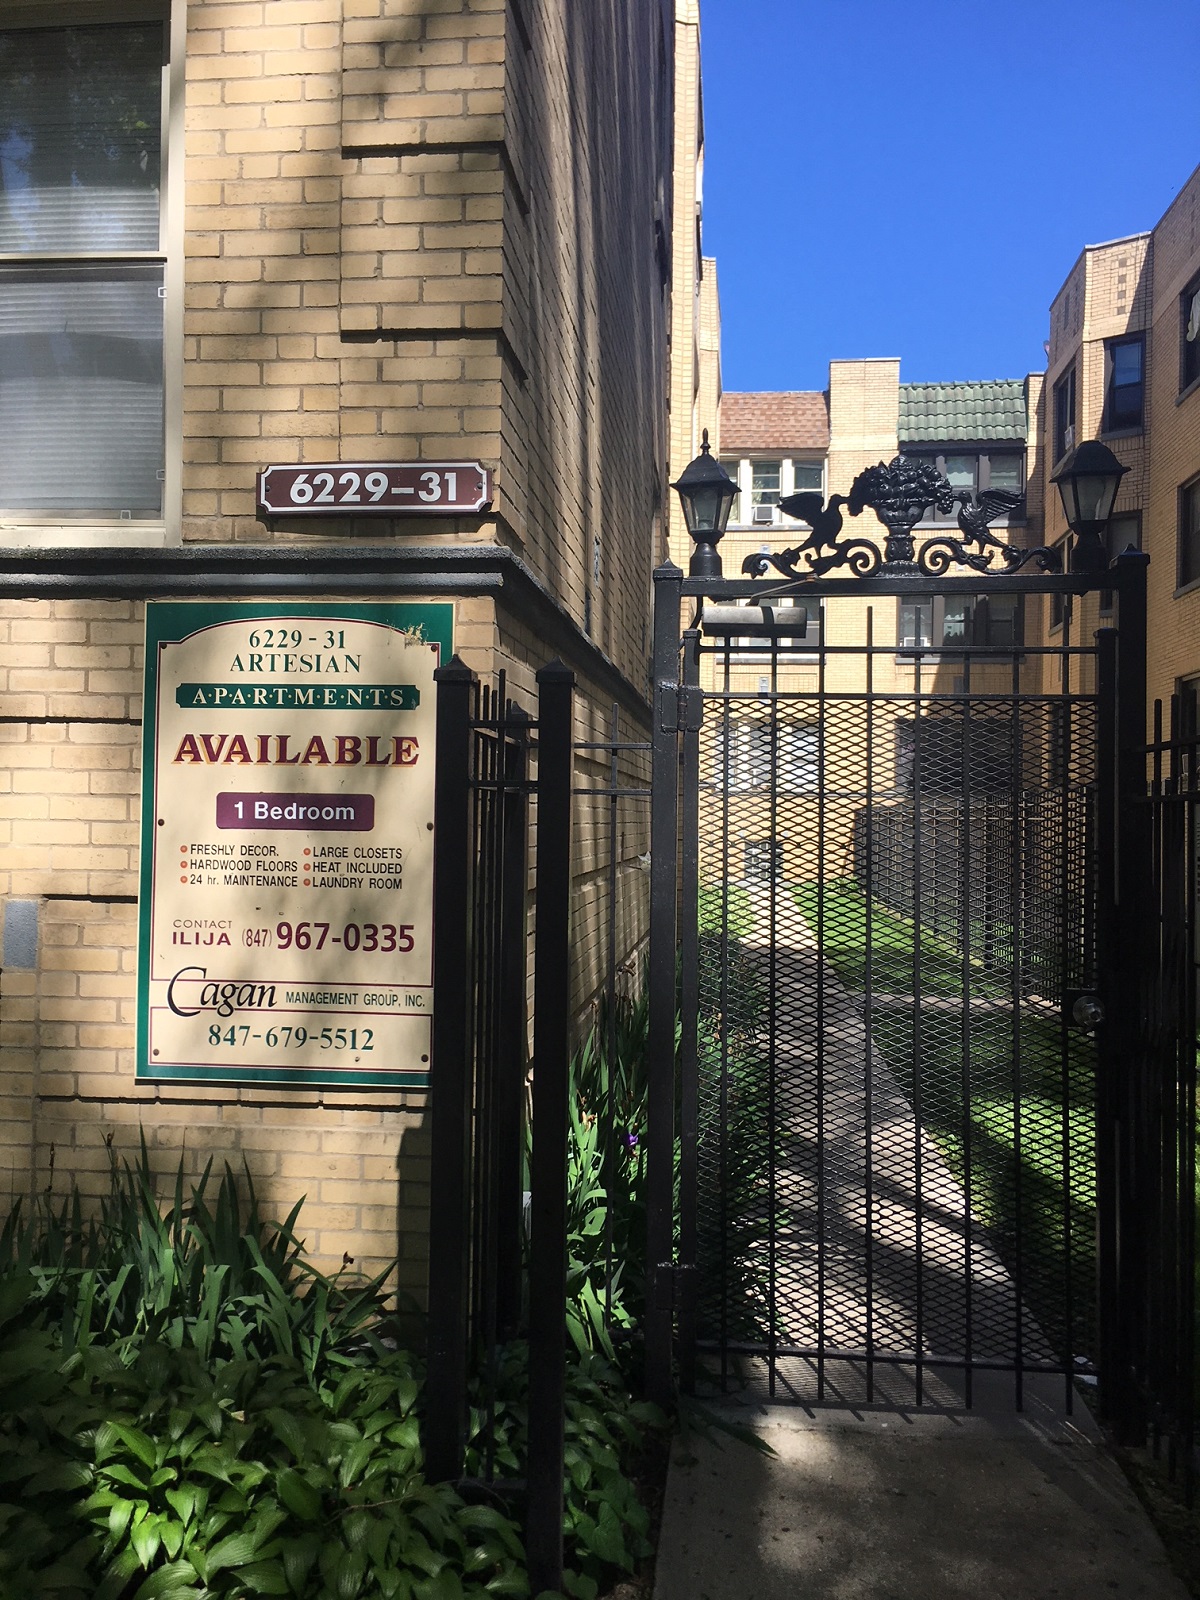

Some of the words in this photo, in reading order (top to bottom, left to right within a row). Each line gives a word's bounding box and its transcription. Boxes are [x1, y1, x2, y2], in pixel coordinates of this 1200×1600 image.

[230, 653, 362, 673] ARTESIAN
[171, 733, 419, 767] AVAILABLE
[234, 801, 244, 819] 1
[254, 801, 356, 820] Bedroom
[190, 844, 235, 856] FRESHLY
[240, 845, 279, 857] DECOR.
[313, 847, 348, 858] LARGE
[353, 848, 402, 859] CLOSETS
[190, 859, 251, 871] HARDWOOD
[256, 860, 298, 872] FLOORS
[313, 862, 341, 874] HEAT
[346, 863, 402, 875] INCLUDED
[190, 874, 202, 885] 24
[207, 874, 220, 886] hr.
[223, 875, 298, 887] MAINTENANCE
[312, 877, 364, 889] LAUNDRY
[369, 878, 402, 890] ROOM
[173, 919, 233, 929] CONTACT
[172, 931, 232, 946] ILIJA
[241, 928, 272, 948] (847)
[276, 922, 415, 952] 967-0335
[167, 966, 278, 1017] Cagan
[285, 991, 358, 1005] MANAGEMENT
[363, 993, 401, 1007] GROUP,
[405, 995, 425, 1007] INC.
[208, 1023, 374, 1051] 847-679-5512
